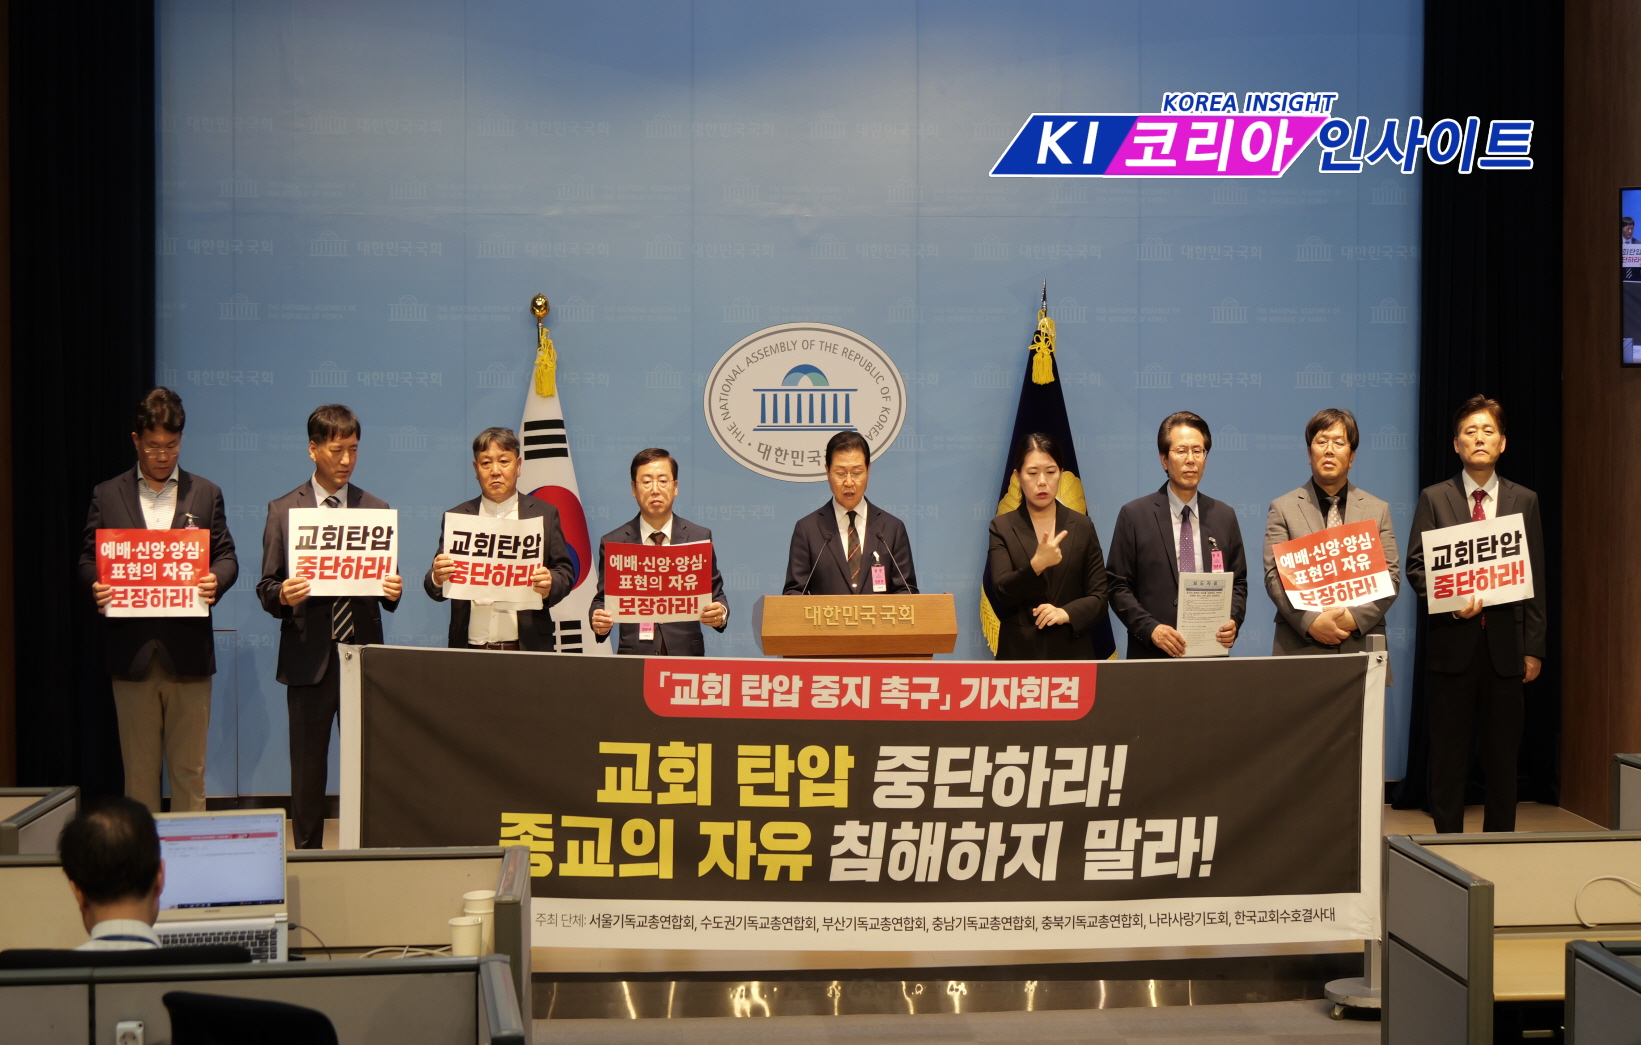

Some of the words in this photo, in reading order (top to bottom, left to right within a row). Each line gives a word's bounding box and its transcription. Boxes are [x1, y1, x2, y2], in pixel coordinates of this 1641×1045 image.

[745, 340, 798, 367] ASSEMBLY
[802, 339, 816, 350] OF
[819, 341, 840, 355] THE
[841, 347, 885, 385] REPUBLIC
[719, 364, 745, 421] NATIONAL
[880, 386, 892, 402] OF
[726, 421, 745, 444] THE
[864, 406, 891, 442] KOREA
[757, 441, 827, 467] 대한민국
[295, 525, 394, 551] 교회탄압
[449, 530, 541, 560] 교회탄압
[1431, 530, 1522, 571] 교회탄압
[111, 562, 157, 581] 표현의
[162, 562, 194, 581] 자유
[295, 556, 392, 580] 중단하라!
[1293, 560, 1338, 585] 표현의
[1341, 553, 1371, 573] 자유
[1434, 560, 1525, 599] 중단하라!
[619, 574, 662, 591] 표현의
[668, 574, 698, 591] 자유
[1299, 576, 1378, 606] 보장하라!
[111, 588, 194, 608] 보장하라!
[619, 597, 698, 615] 보장하라!
[660, 671, 731, 707] 「교회
[740, 675, 803, 708] 탄압
[810, 675, 870, 709] 중지
[880, 676, 951, 711] 촉구」
[960, 676, 1079, 710] 기자회견
[596, 741, 713, 806] 교회
[737, 744, 855, 809] 탄압
[872, 744, 1128, 809] 중단하라!
[498, 812, 674, 880] 종교의
[698, 820, 812, 882] 자유
[829, 820, 1064, 882] 침해하지
[1083, 816, 1218, 881] 말라!
[535, 913, 558, 928] 주최
[561, 913, 587, 928] 단체:
[589, 914, 698, 932] 서울기독교총연합회,
[700, 915, 819, 933] 수도권기독교총연합회,
[822, 916, 929, 933] 부산기독교총연합회,
[932, 915, 1038, 933] 충남기독교총연합회,
[1041, 913, 1147, 932] 충북기독교총연합회,
[1149, 910, 1231, 928] 나라사랑기도회,
[1234, 907, 1335, 925] 한국교회수호결사대
